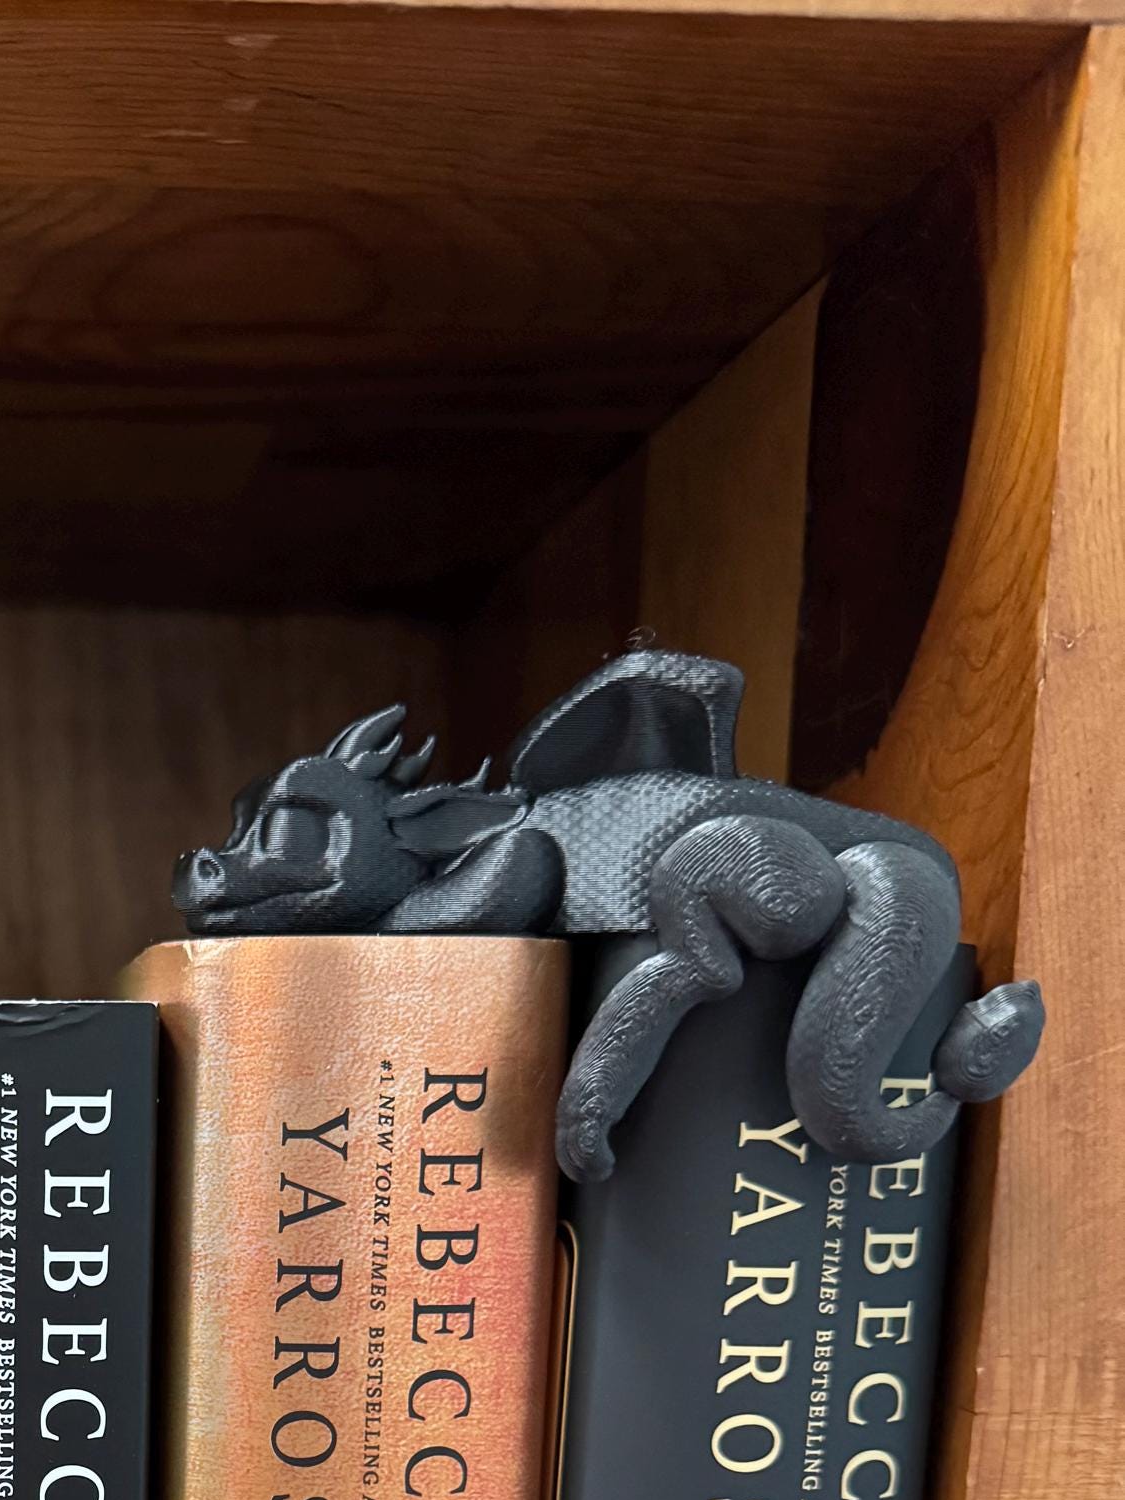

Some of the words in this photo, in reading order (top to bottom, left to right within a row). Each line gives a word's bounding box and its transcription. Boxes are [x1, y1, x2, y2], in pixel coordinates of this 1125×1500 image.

[0, 1072, 18, 1098] #1
[379, 1060, 395, 1085] #1
[0, 1106, 18, 1168] NEW
[376, 1093, 395, 1153] NEW
[0, 1174, 18, 1241] YORK
[373, 1161, 393, 1227] YORK
[825, 1163, 850, 1231] YORK
[369, 1234, 389, 1312] TIMES
[818, 1238, 844, 1316] TIMES
[362, 1325, 385, 1487] BESTSELLING
[801, 1329, 835, 1491] BESTSELLING
